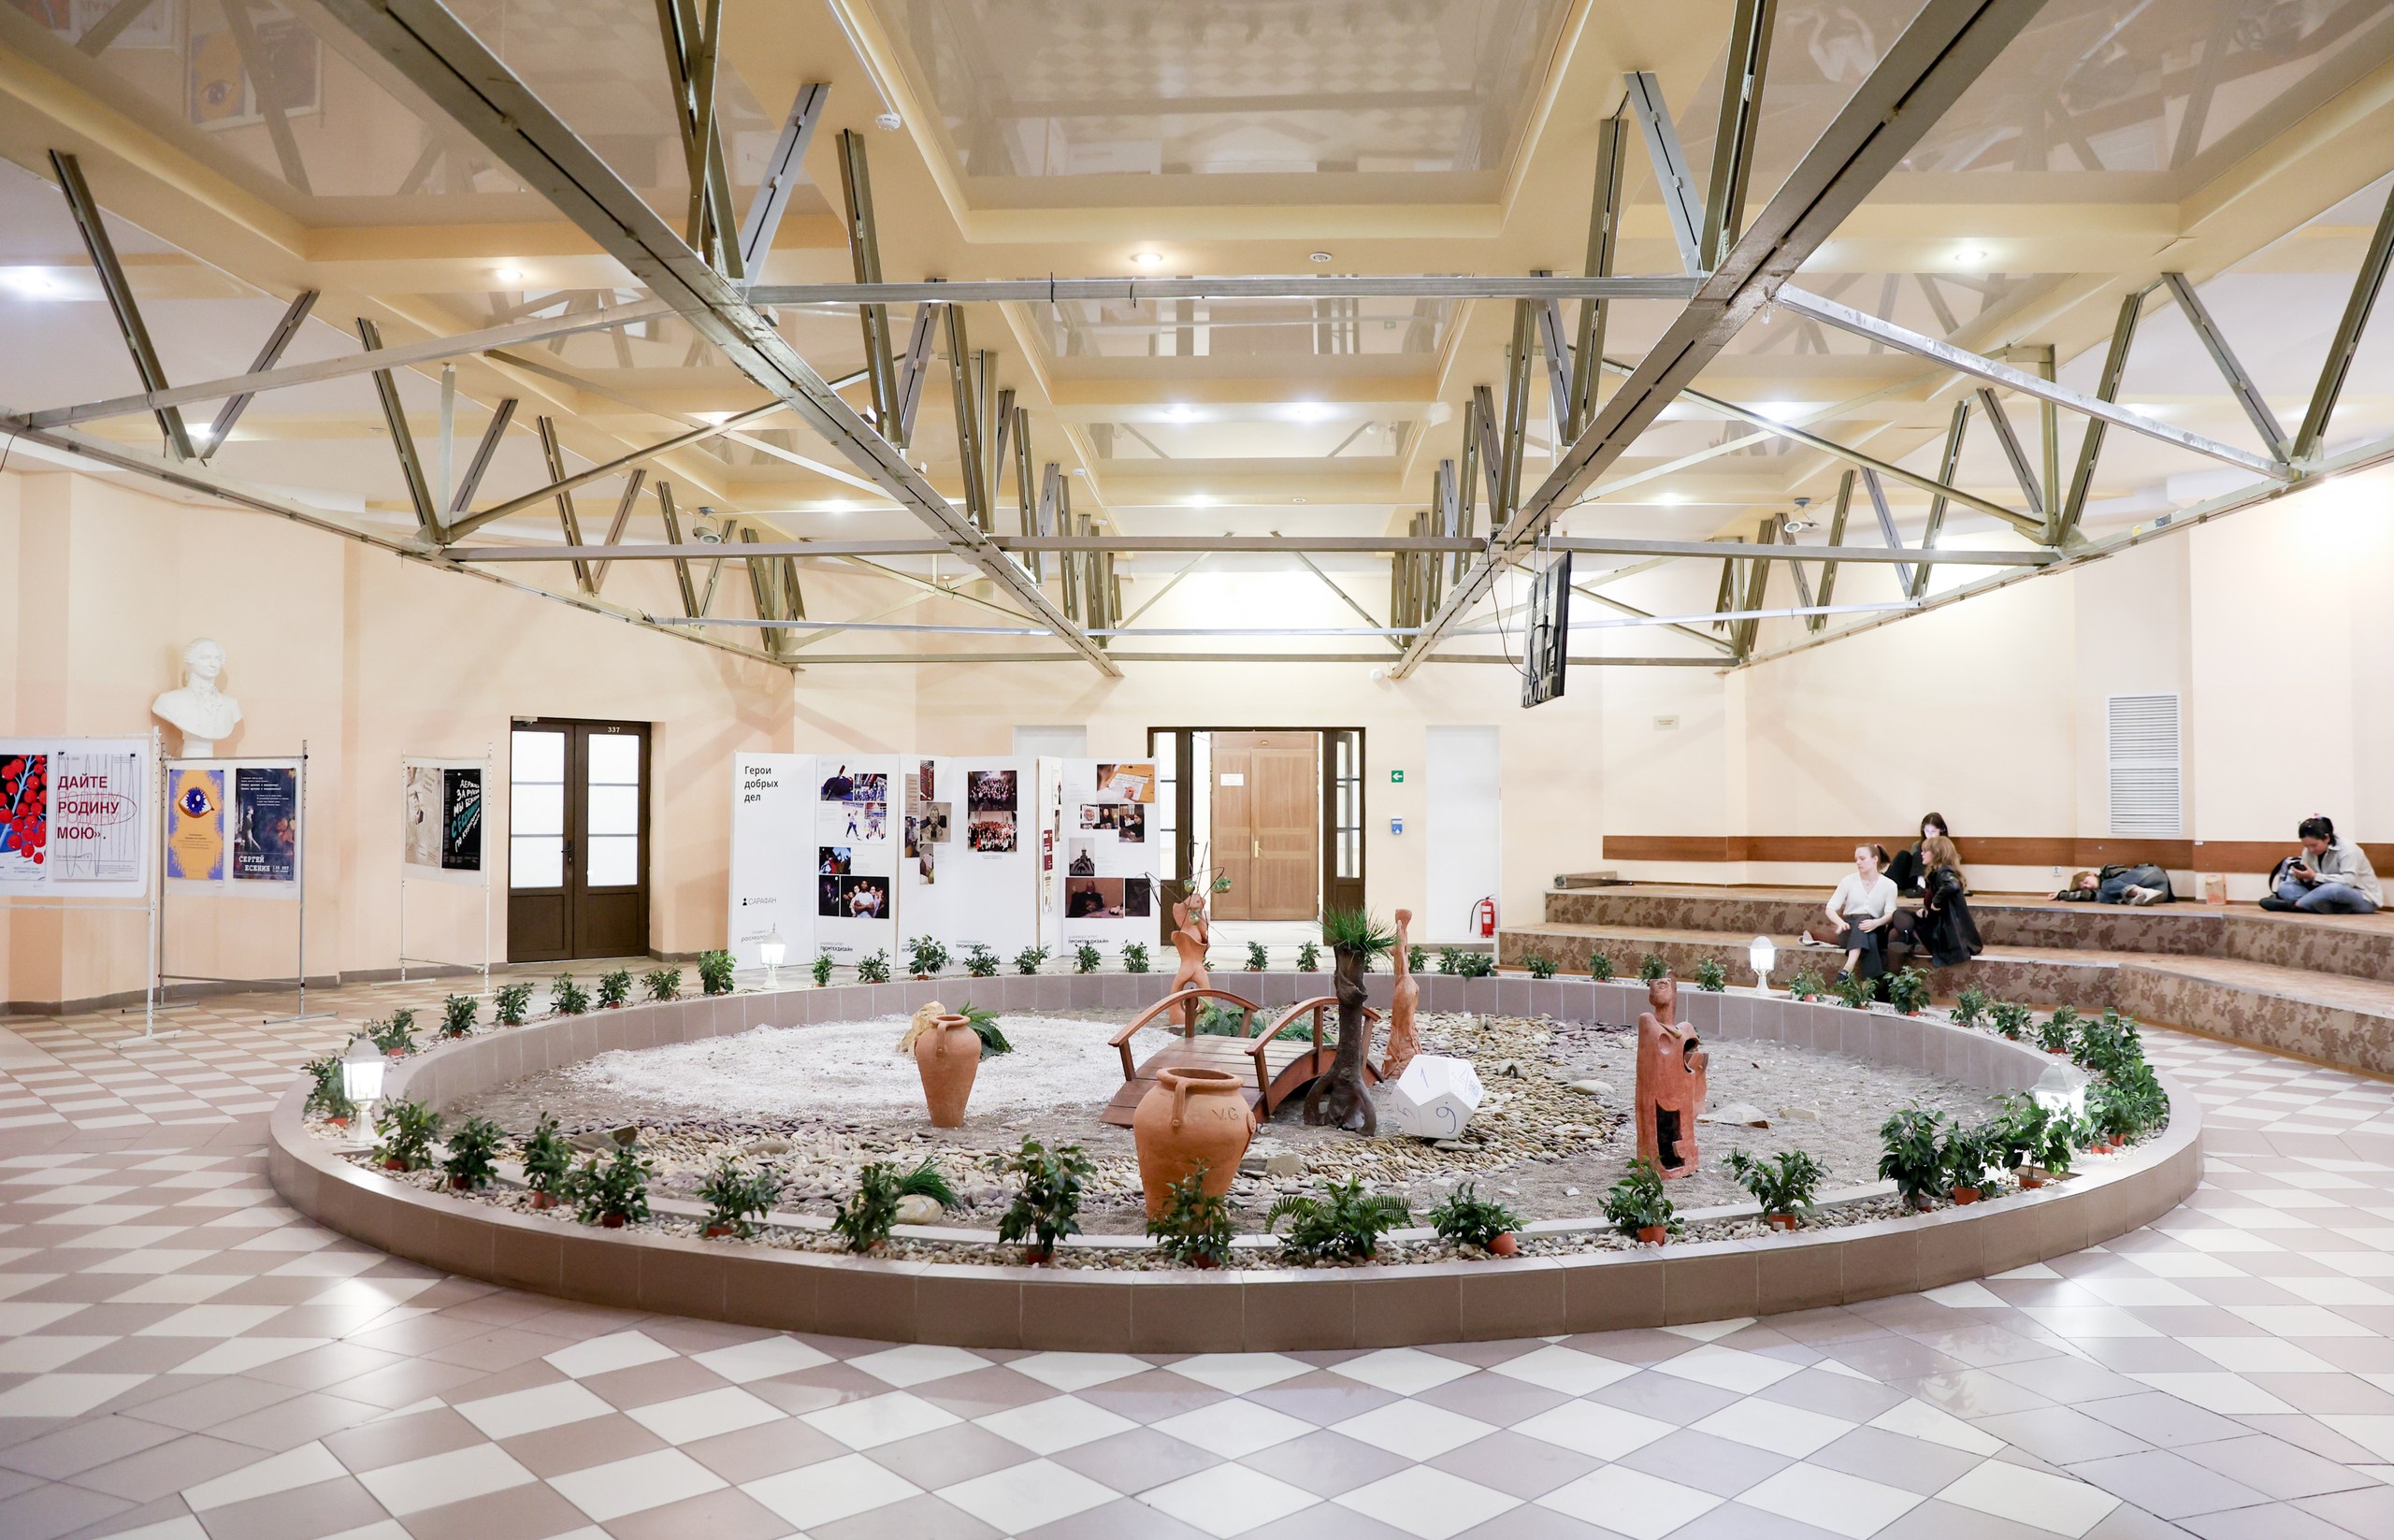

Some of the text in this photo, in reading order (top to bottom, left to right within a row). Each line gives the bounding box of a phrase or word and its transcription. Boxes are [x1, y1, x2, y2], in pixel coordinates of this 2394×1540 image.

[744, 766, 772, 777] Герои
[58, 773, 108, 790] ДАЙТЕ
[743, 779, 779, 790] добрых
[743, 794, 761, 804] дел
[58, 801, 120, 815] РОДИНУ
[238, 855, 265, 863] СЕРГЕЙ
[748, 897, 777, 905] САРАФАН
